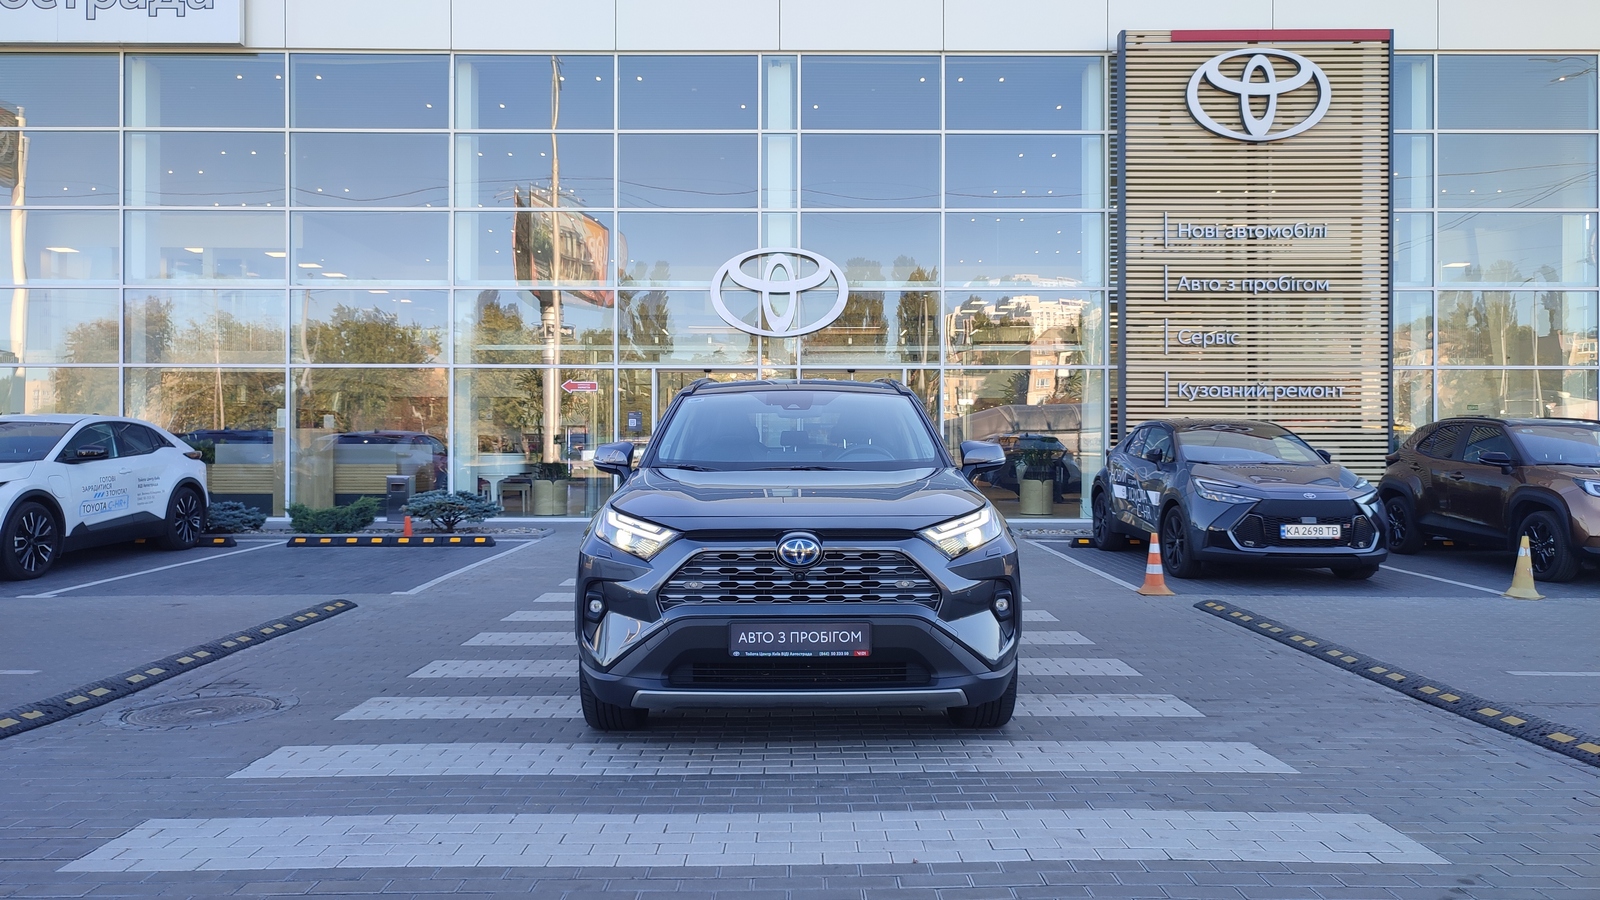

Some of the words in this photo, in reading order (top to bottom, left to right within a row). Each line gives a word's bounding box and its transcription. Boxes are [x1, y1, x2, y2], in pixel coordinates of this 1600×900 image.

[1177, 223, 1219, 238] Нові
[1225, 223, 1328, 238] автомобілі
[1177, 275, 1221, 292] Авто
[1226, 278, 1236, 292] з
[1241, 275, 1330, 295] пробігом
[1177, 329, 1241, 348] Сервіс
[1177, 382, 1268, 401] Кузовний
[1273, 388, 1345, 401] ремонт
[82, 502, 106, 513] TOYOTA
[1301, 526, 1324, 536] 2698
[738, 631, 774, 644] АВТО
[777, 631, 787, 644] З
[790, 630, 863, 644] ПРОБІГОМ
